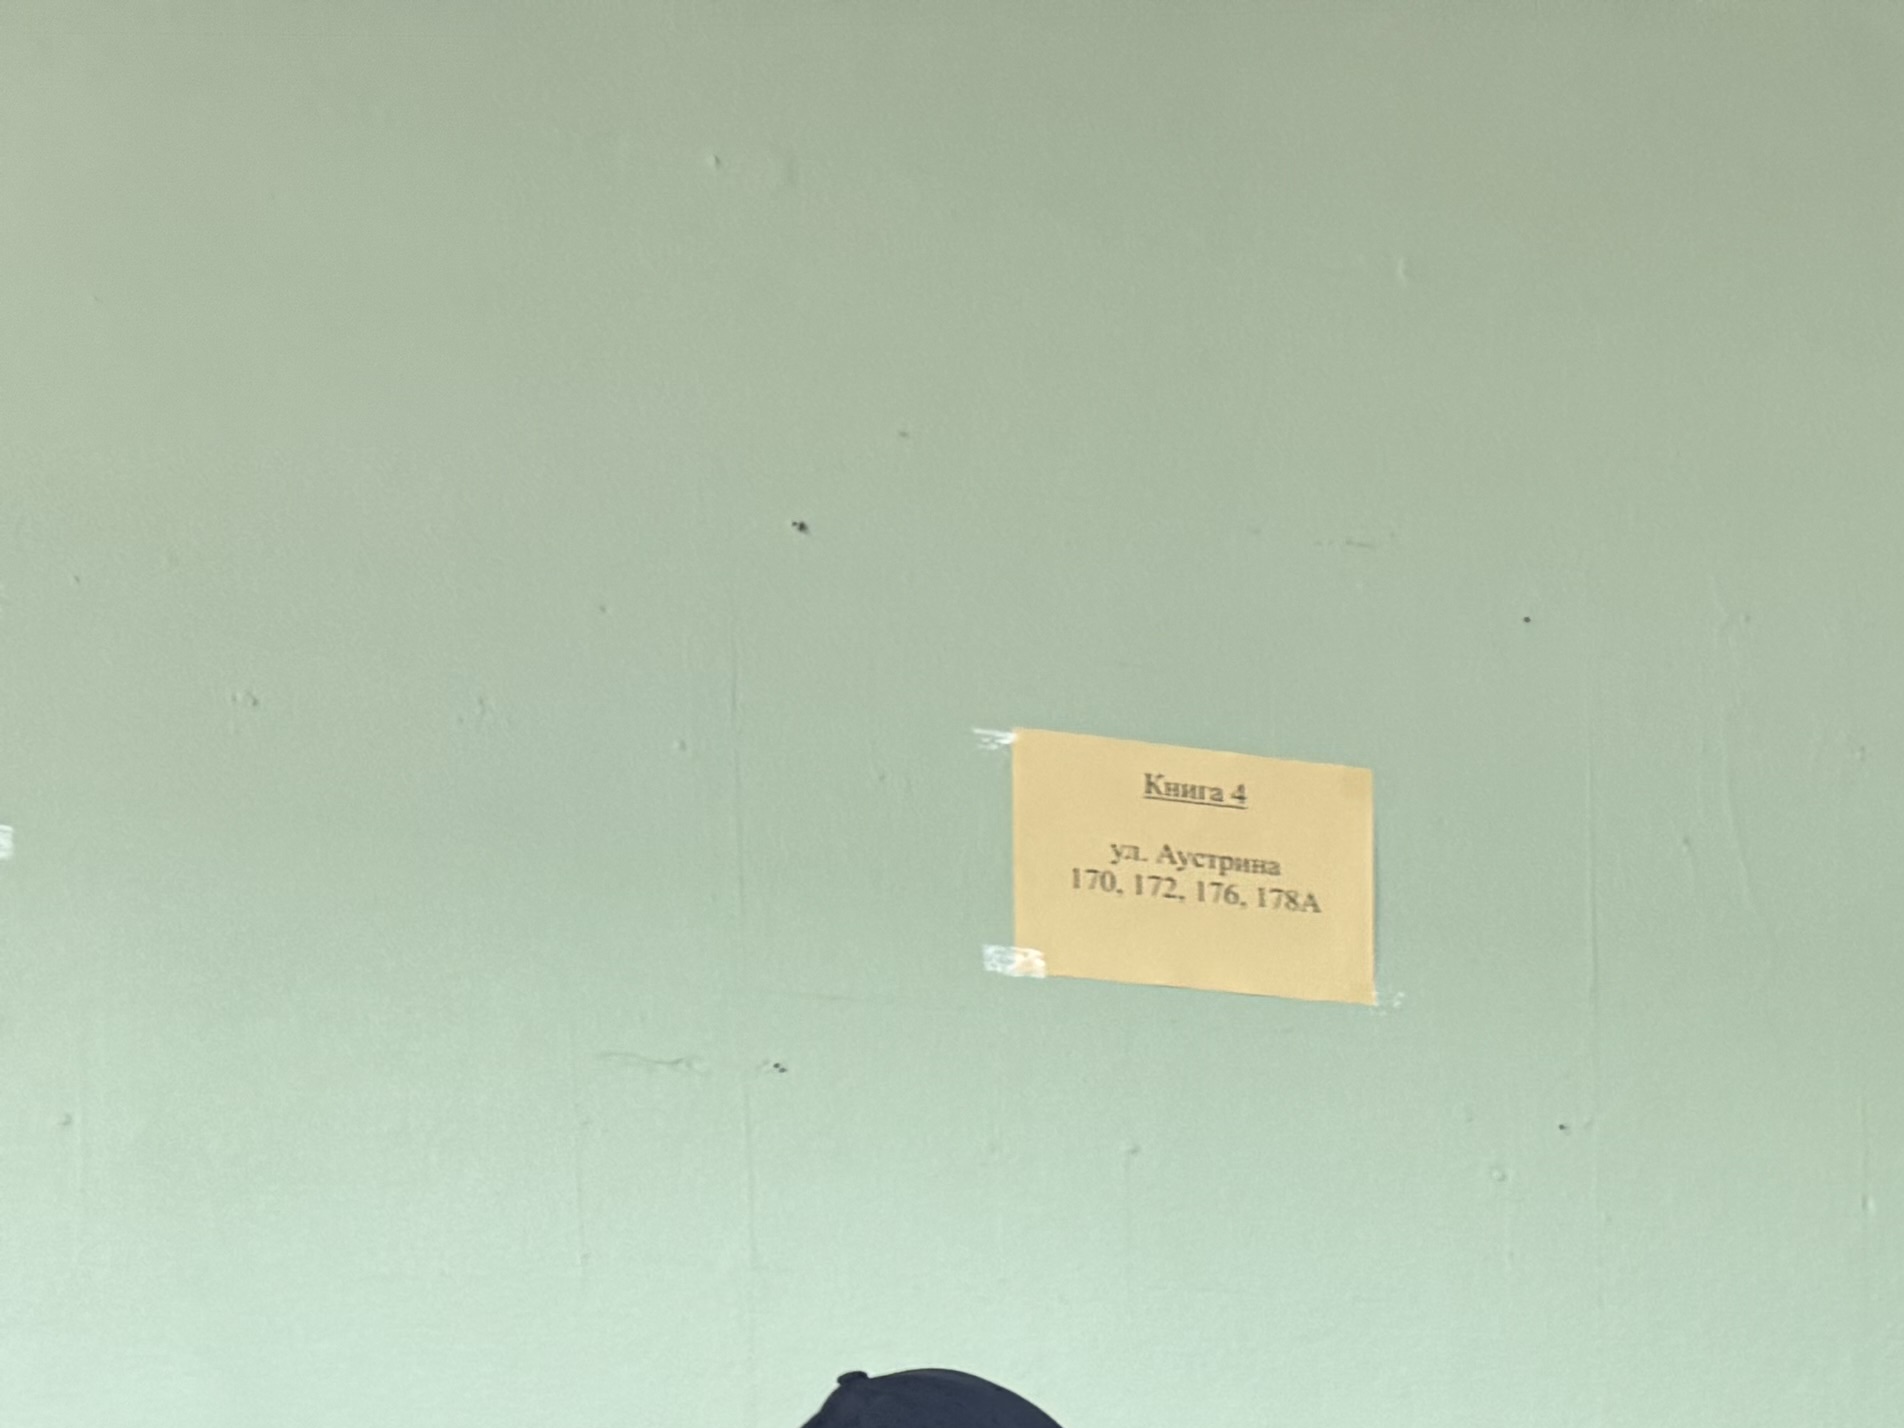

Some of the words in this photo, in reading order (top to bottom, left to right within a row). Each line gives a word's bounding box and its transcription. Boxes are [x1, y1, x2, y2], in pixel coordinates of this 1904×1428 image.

[1143, 772, 1224, 802] Книга
[1230, 783, 1248, 804] 4
[1109, 842, 1149, 866] ул.
[1155, 842, 1282, 877] Аустрина
[1071, 866, 1124, 895] 170,
[1134, 873, 1186, 900] 172,
[1197, 880, 1248, 907] 176,
[1257, 886, 1323, 914] 178А
